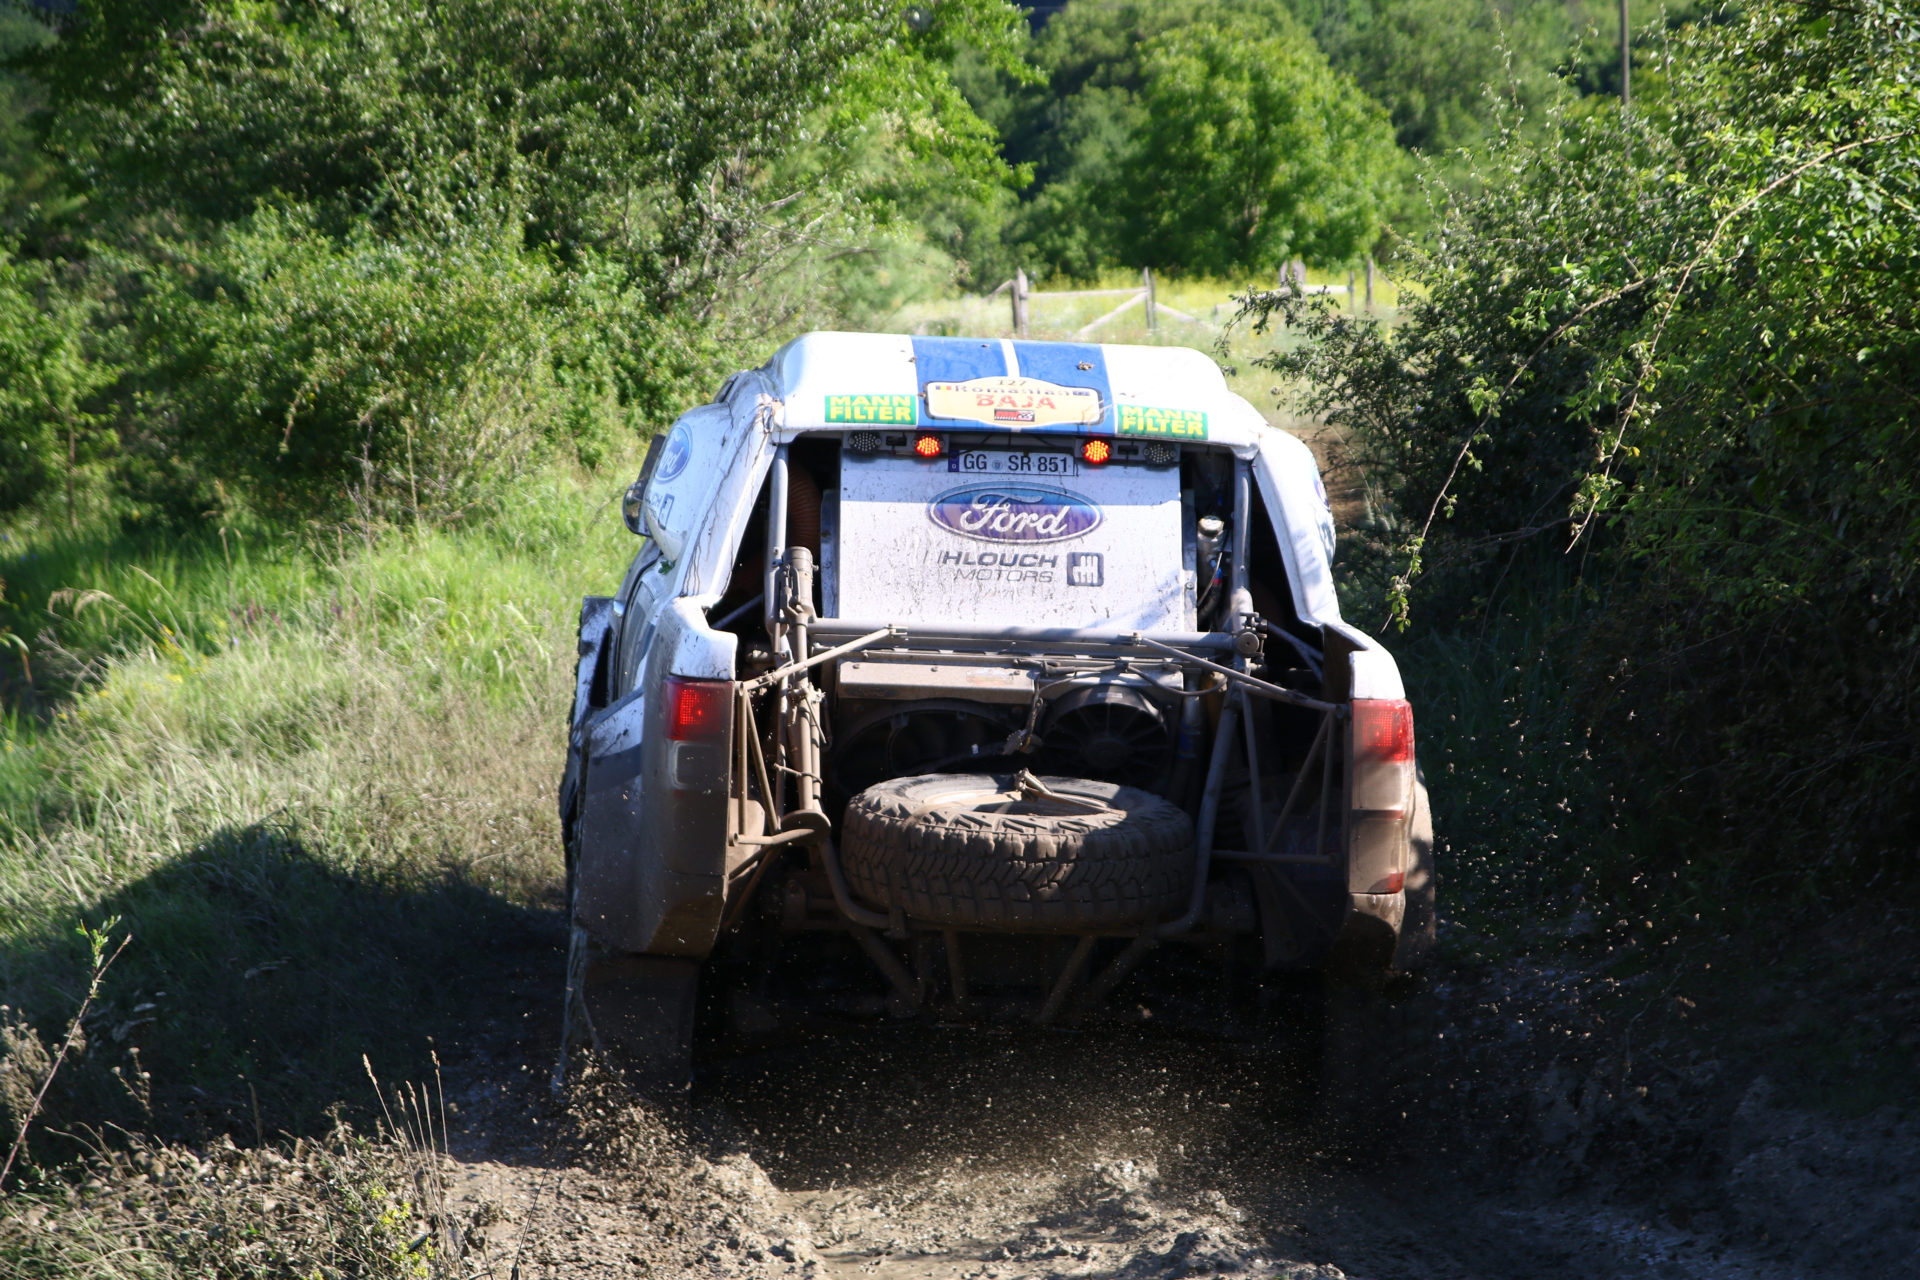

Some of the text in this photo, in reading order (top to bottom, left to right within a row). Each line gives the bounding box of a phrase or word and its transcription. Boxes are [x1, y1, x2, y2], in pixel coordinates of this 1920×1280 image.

[829, 395, 911, 406] MANN
[976, 394, 1057, 410] BAJA
[829, 406, 912, 421] FILTER
[1121, 405, 1203, 421] MANN
[1122, 415, 1204, 436] FILTER
[963, 453, 1069, 473] GG SR 851
[960, 492, 1072, 535] Ford
[942, 550, 1059, 568] HLOUCH
[953, 567, 1054, 583] MOTORS
